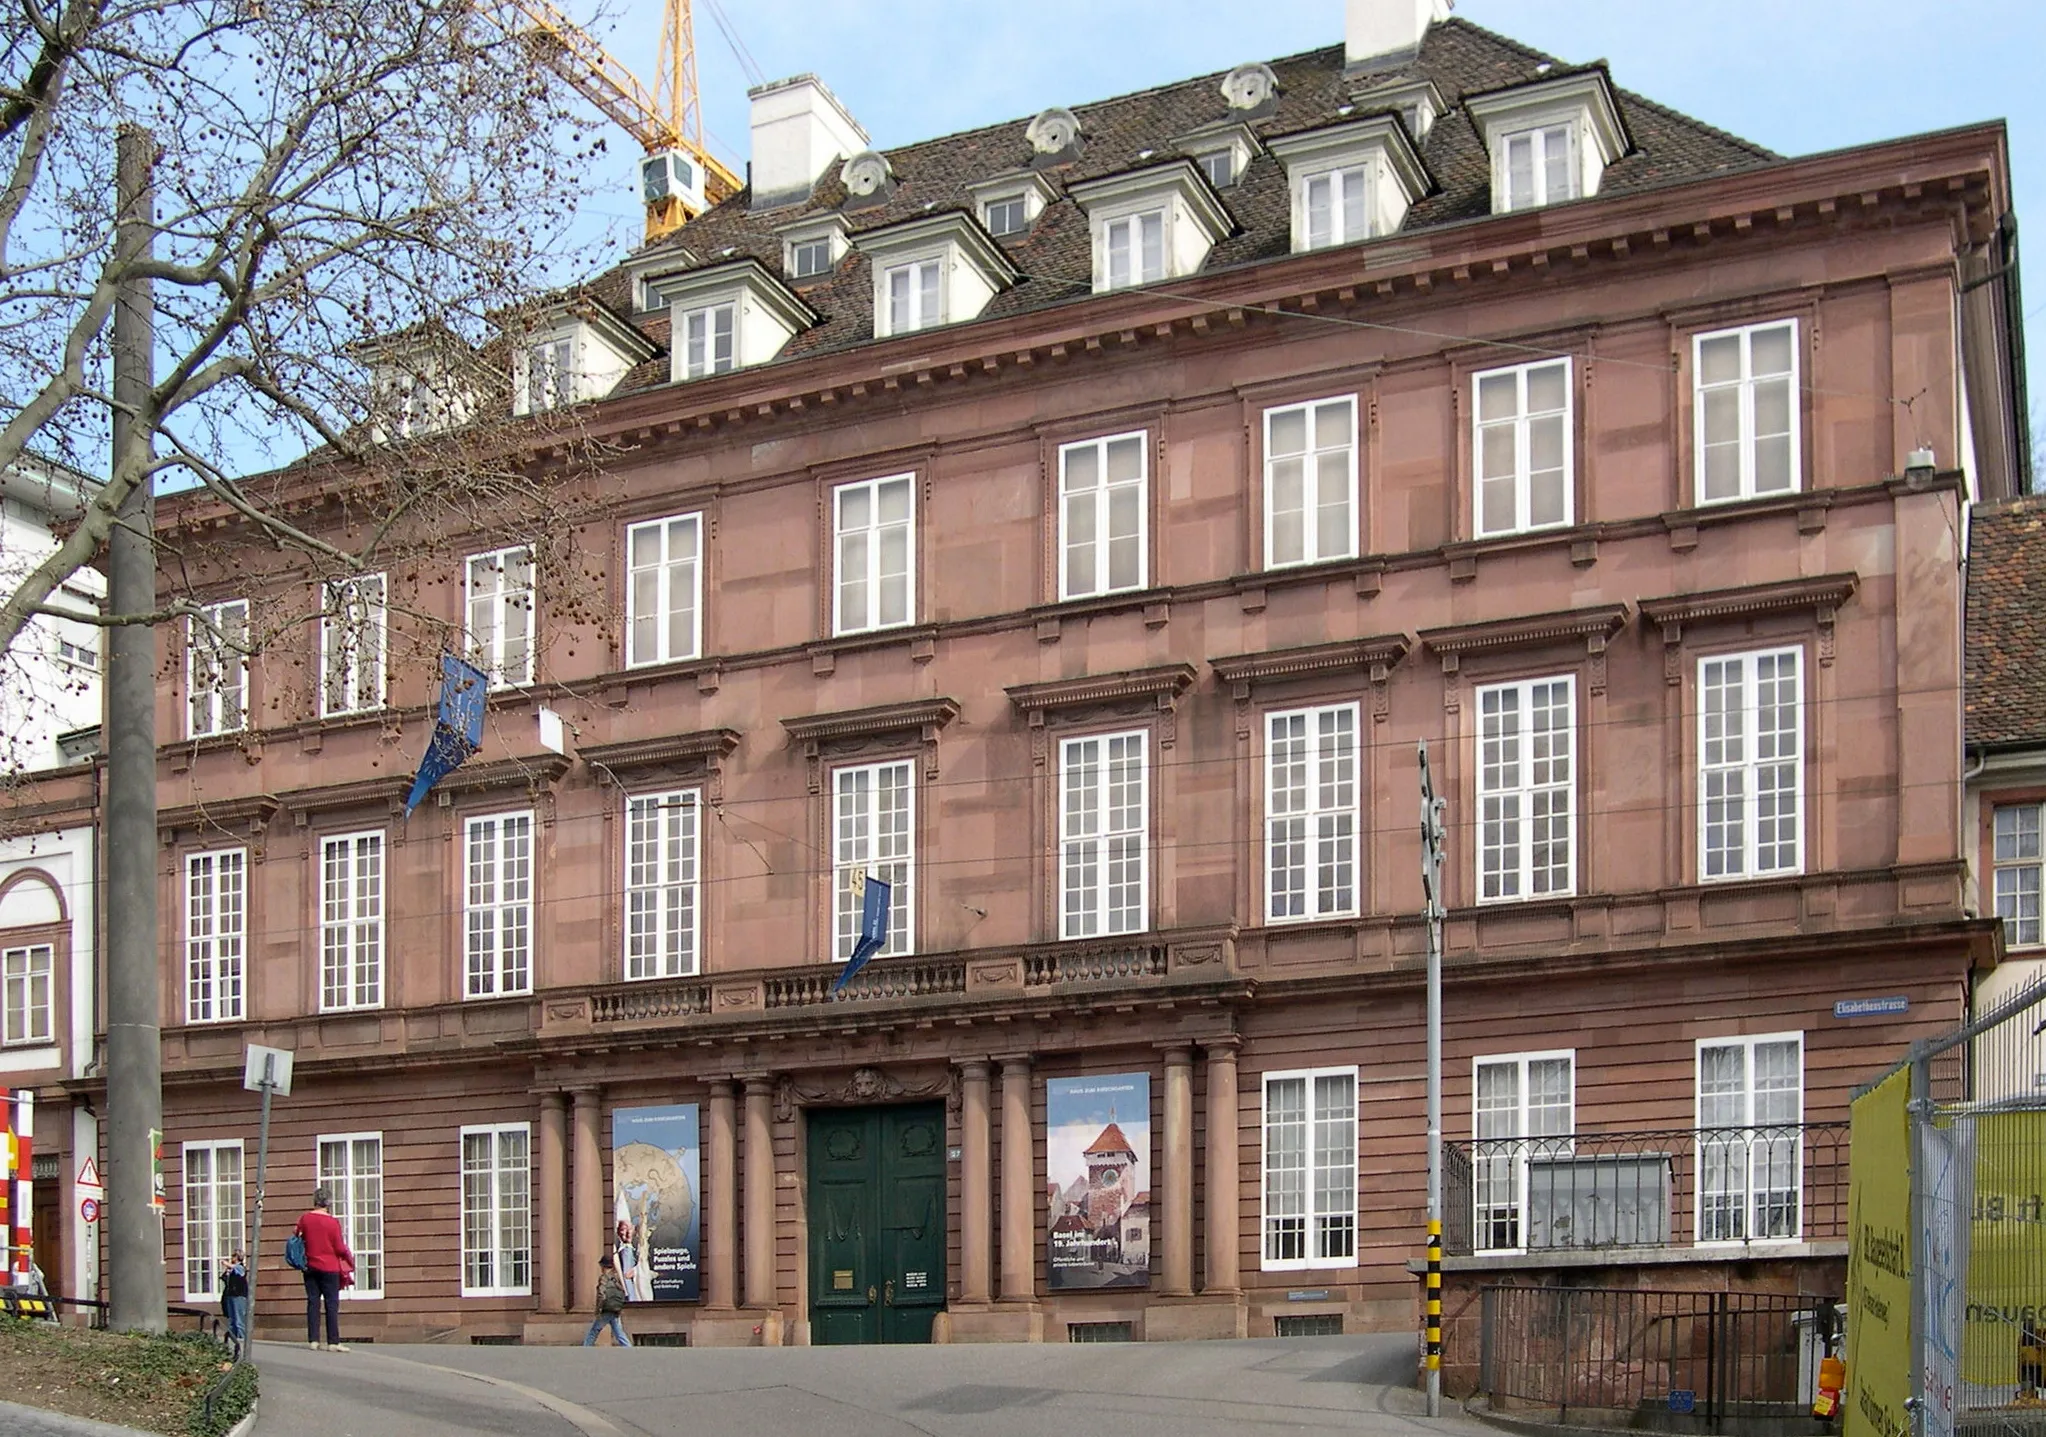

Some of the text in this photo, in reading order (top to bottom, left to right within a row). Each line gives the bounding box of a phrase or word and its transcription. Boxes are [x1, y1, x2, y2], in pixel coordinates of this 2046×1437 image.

[1836, 999, 1906, 1014] Elisabethenstrasse
[1053, 1231, 1073, 1239] Basel
[676, 1263, 697, 1271] Spiele
